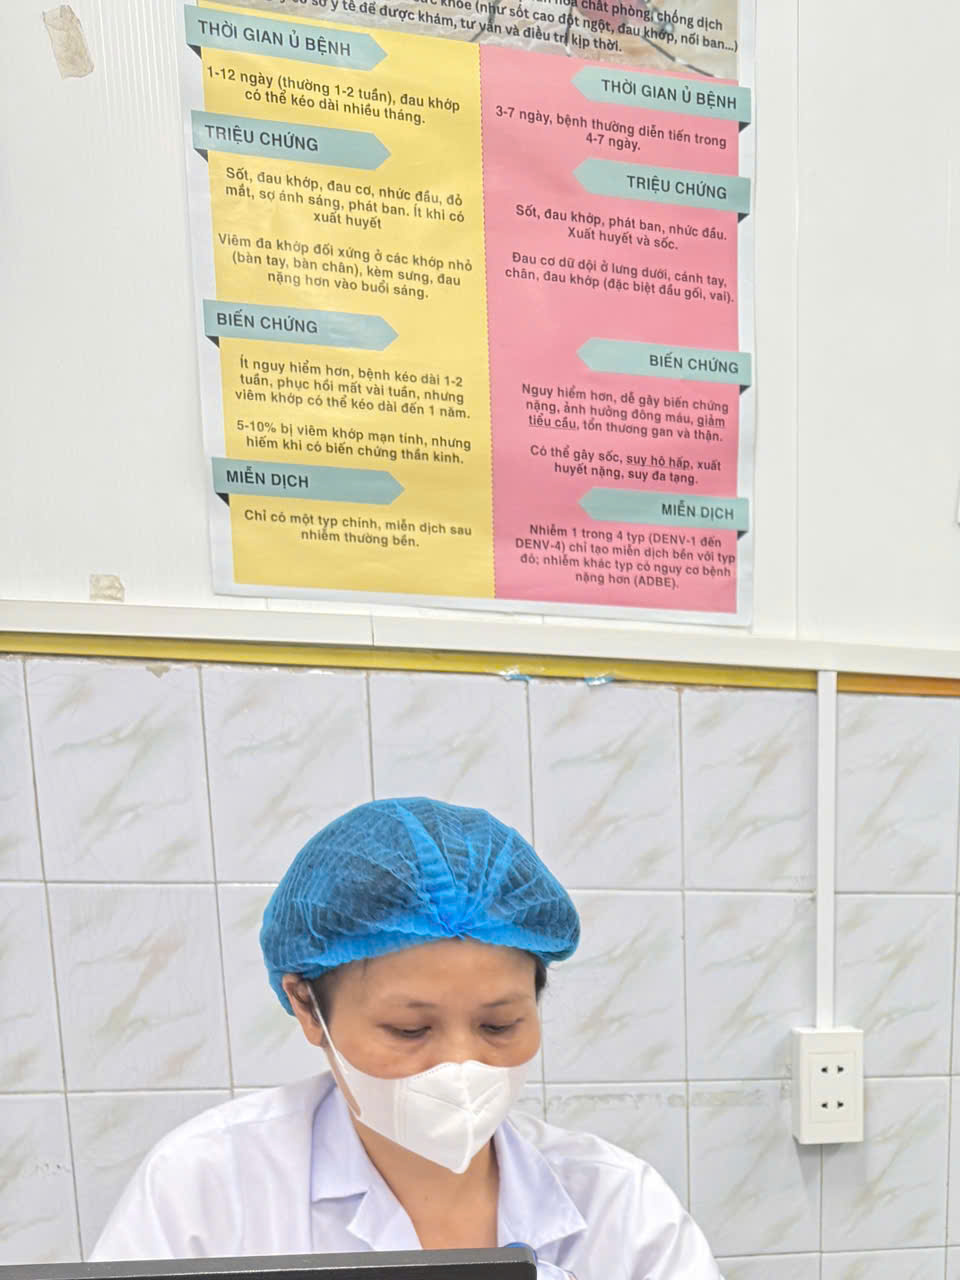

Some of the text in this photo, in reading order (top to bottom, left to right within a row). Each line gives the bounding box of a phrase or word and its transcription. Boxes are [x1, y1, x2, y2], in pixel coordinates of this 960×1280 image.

[380, 4, 415, 22] được
[418, 10, 457, 29] khám,
[460, 18, 476, 29] tư
[505, 24, 520, 36] và
[523, 26, 550, 41] điều
[572, 33, 590, 49] kịp
[594, 38, 622, 52] thời.
[509, 4, 529, 19] sốt
[533, 11, 555, 23] cao
[558, 13, 580, 28] đột
[583, 19, 614, 34] ngột,
[618, 22, 640, 36] đau
[644, 26, 677, 45] khớp,
[657, 10, 694, 29] chống
[697, 17, 723, 31] dịch
[198, 20, 350, 57] THỜI GIAN Ủ BỆNH
[208, 66, 235, 81] 1-12
[240, 72, 273, 89] ngày
[278, 75, 329, 97] (thường
[335, 85, 354, 98] 1-2
[400, 94, 424, 107] đau
[428, 96, 460, 114] khớp
[245, 88, 261, 102] có
[265, 90, 286, 105] thể
[291, 94, 314, 108] kéo
[319, 98, 338, 112] dài
[344, 103, 380, 118] nhiều
[602, 79, 736, 110] THỜI GIAN Ủ BỆNH
[205, 125, 318, 152] TRIỆU CHỨNG
[496, 105, 514, 118] 3-7
[557, 113, 587, 129] bệnh
[592, 119, 634, 138] thường
[639, 125, 664, 139] diễn
[669, 129, 690, 143] tiến
[695, 134, 726, 150] trong
[586, 132, 604, 145] 4-7
[257, 172, 281, 185] đau
[327, 180, 351, 193] đau
[379, 187, 410, 201] nhức
[446, 194, 462, 207] đỏ
[627, 175, 726, 200] TRIỆU CHỨNG
[260, 190, 275, 202] sợ
[280, 190, 303, 204] ánh
[349, 200, 377, 213] phát
[414, 203, 422, 218] Ít
[426, 208, 444, 221] khi
[449, 211, 464, 223] có
[314, 209, 381, 230] xuất huyết
[544, 209, 566, 221] đau
[609, 216, 635, 230] phát
[669, 224, 698, 237] nhức
[568, 227, 594, 241] Xuất
[600, 230, 632, 246] huyết
[636, 235, 650, 247] và
[543, 271, 566, 283] đau
[570, 273, 599, 290] khớp
[604, 277, 629, 292] (đặc
[633, 281, 655, 296] biệt
[659, 283, 680, 297] đầu
[217, 309, 317, 334] BIẾN CHỨNG
[240, 354, 248, 369] Ít
[253, 361, 285, 375] nguy
[290, 360, 321, 375] hiểm
[358, 368, 390, 382] bệnh
[395, 371, 417, 383] kéo
[421, 374, 439, 385] dài
[445, 376, 462, 388] 1-2
[650, 352, 738, 374] BIẾN CHỨNG
[237, 420, 276, 433] 5-10%
[281, 423, 292, 437] bị
[297, 425, 327, 438] viêm
[332, 427, 364, 443] khớp
[368, 433, 394, 445] mạn
[432, 436, 470, 452] nhưng
[227, 466, 308, 490] MIỄN DỊCH
[555, 462, 587, 477] huyết
[628, 471, 648, 483] suy
[652, 470, 666, 482] đa
[662, 500, 734, 521] MIỄN DỊCH
[576, 572, 604, 586] nặng
[608, 573, 630, 585] hơn
